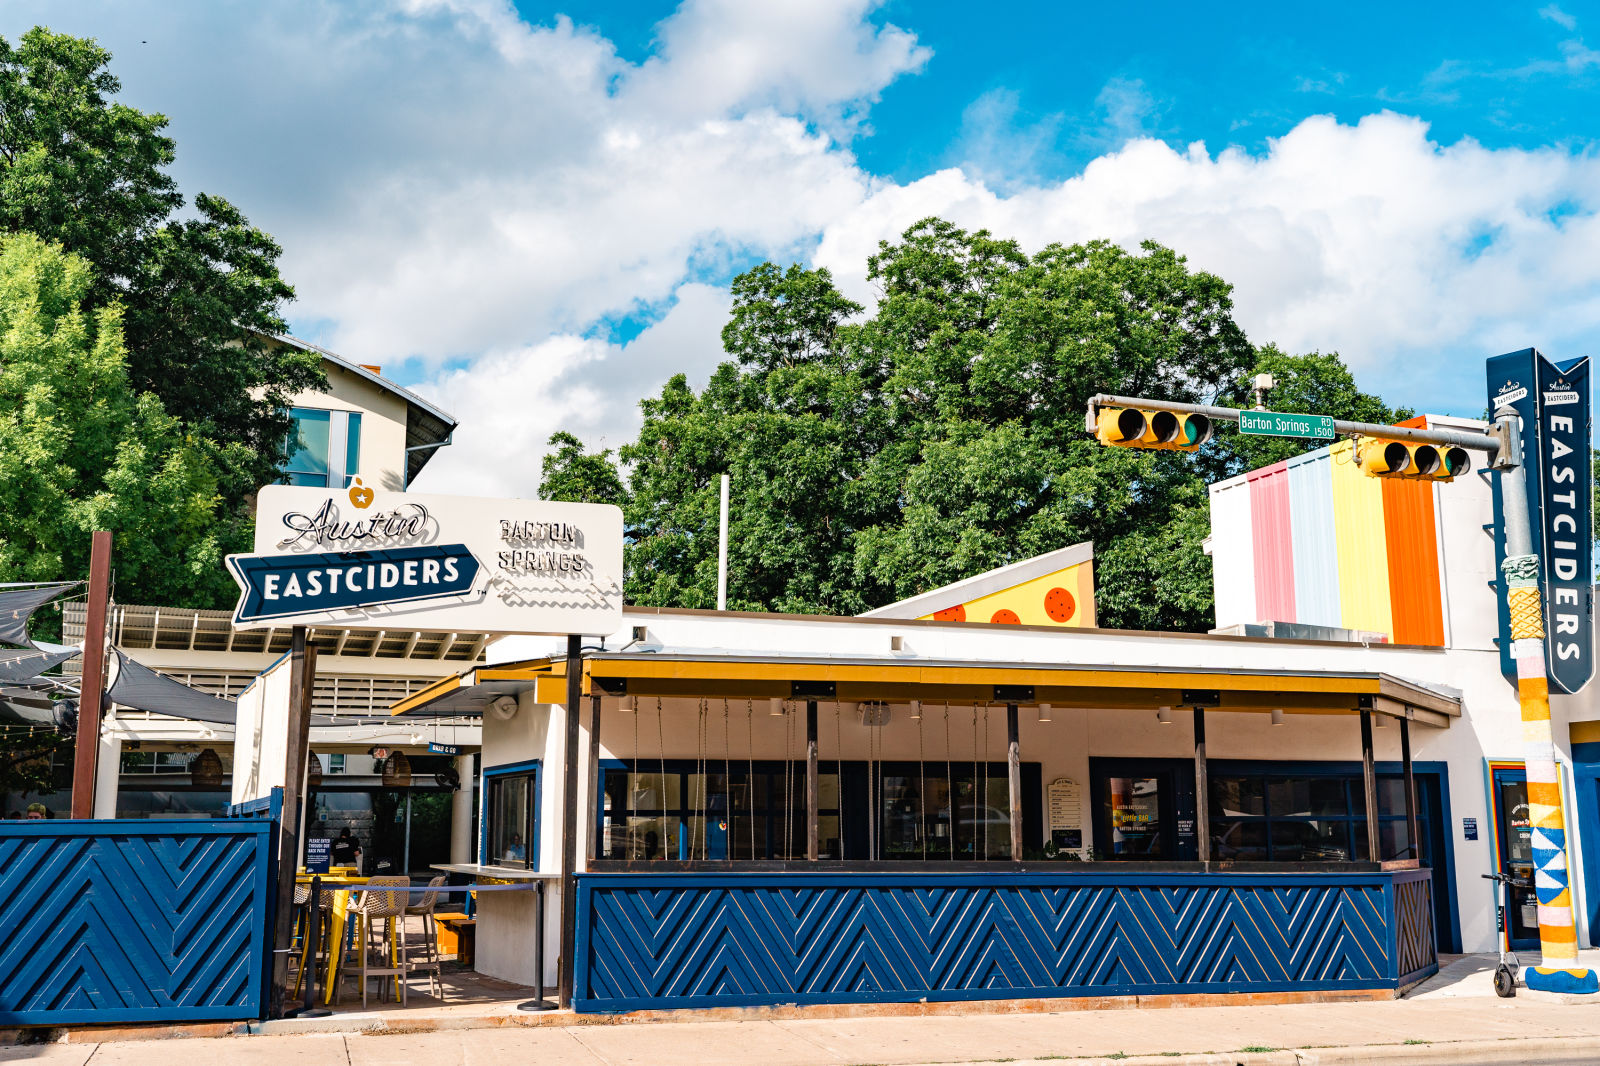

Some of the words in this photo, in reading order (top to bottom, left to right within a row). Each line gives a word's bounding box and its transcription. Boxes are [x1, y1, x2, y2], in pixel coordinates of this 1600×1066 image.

[1498, 381, 1520, 395] Austin
[1549, 382, 1572, 391] Austin
[1497, 389, 1525, 405] EASTCIDERS
[1547, 393, 1577, 402] EASTCIDERS
[1241, 415, 1272, 430] Barton
[1276, 417, 1310, 435] Springs
[1321, 417, 1332, 427] RD
[1314, 427, 1333, 437] 1500
[282, 498, 429, 544] Austin
[499, 519, 575, 542] BARTON
[1550, 415, 1580, 661] EASTCIDERS
[498, 550, 584, 572] SPRINGS
[264, 557, 460, 600] EASTCIDERS
